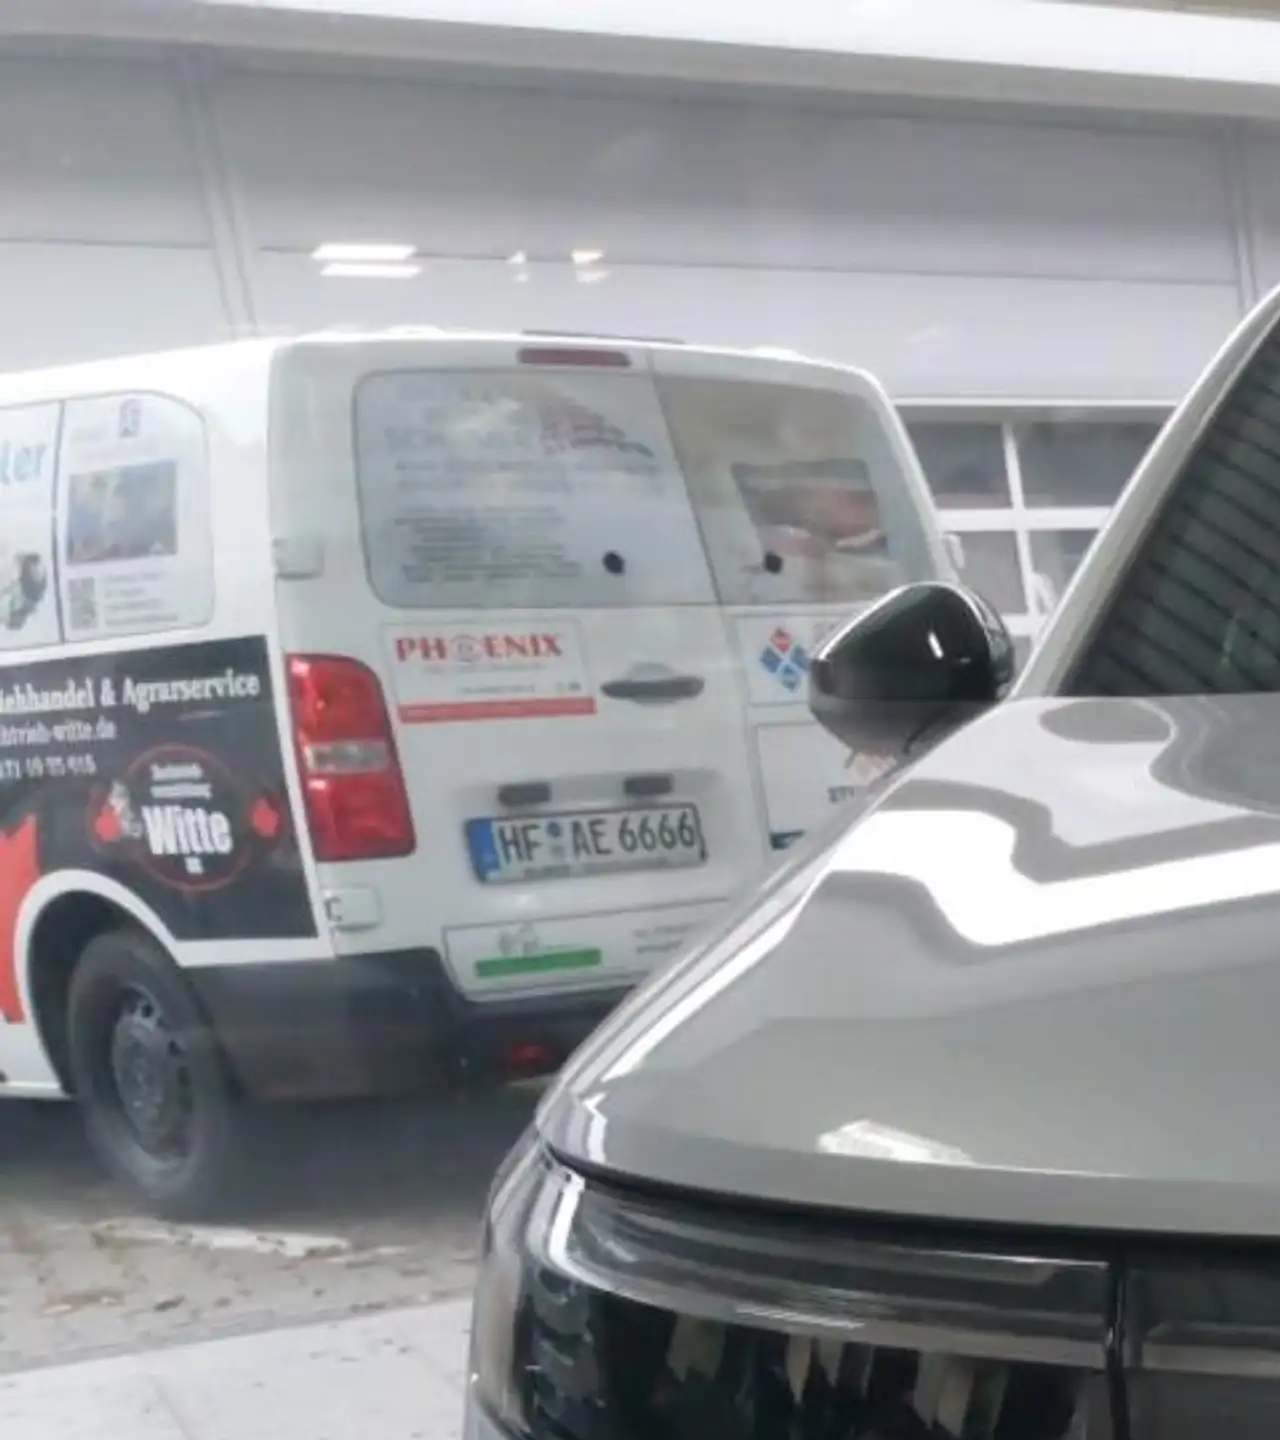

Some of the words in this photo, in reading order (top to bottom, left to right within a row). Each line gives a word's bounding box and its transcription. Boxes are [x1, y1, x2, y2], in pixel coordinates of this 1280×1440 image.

[101, 676, 117, 707] &
[122, 668, 260, 713] Agrarservice
[141, 804, 233, 855] Witte
[497, 823, 543, 865] HF
[570, 817, 613, 860] AE
[618, 810, 696, 853] 6666
